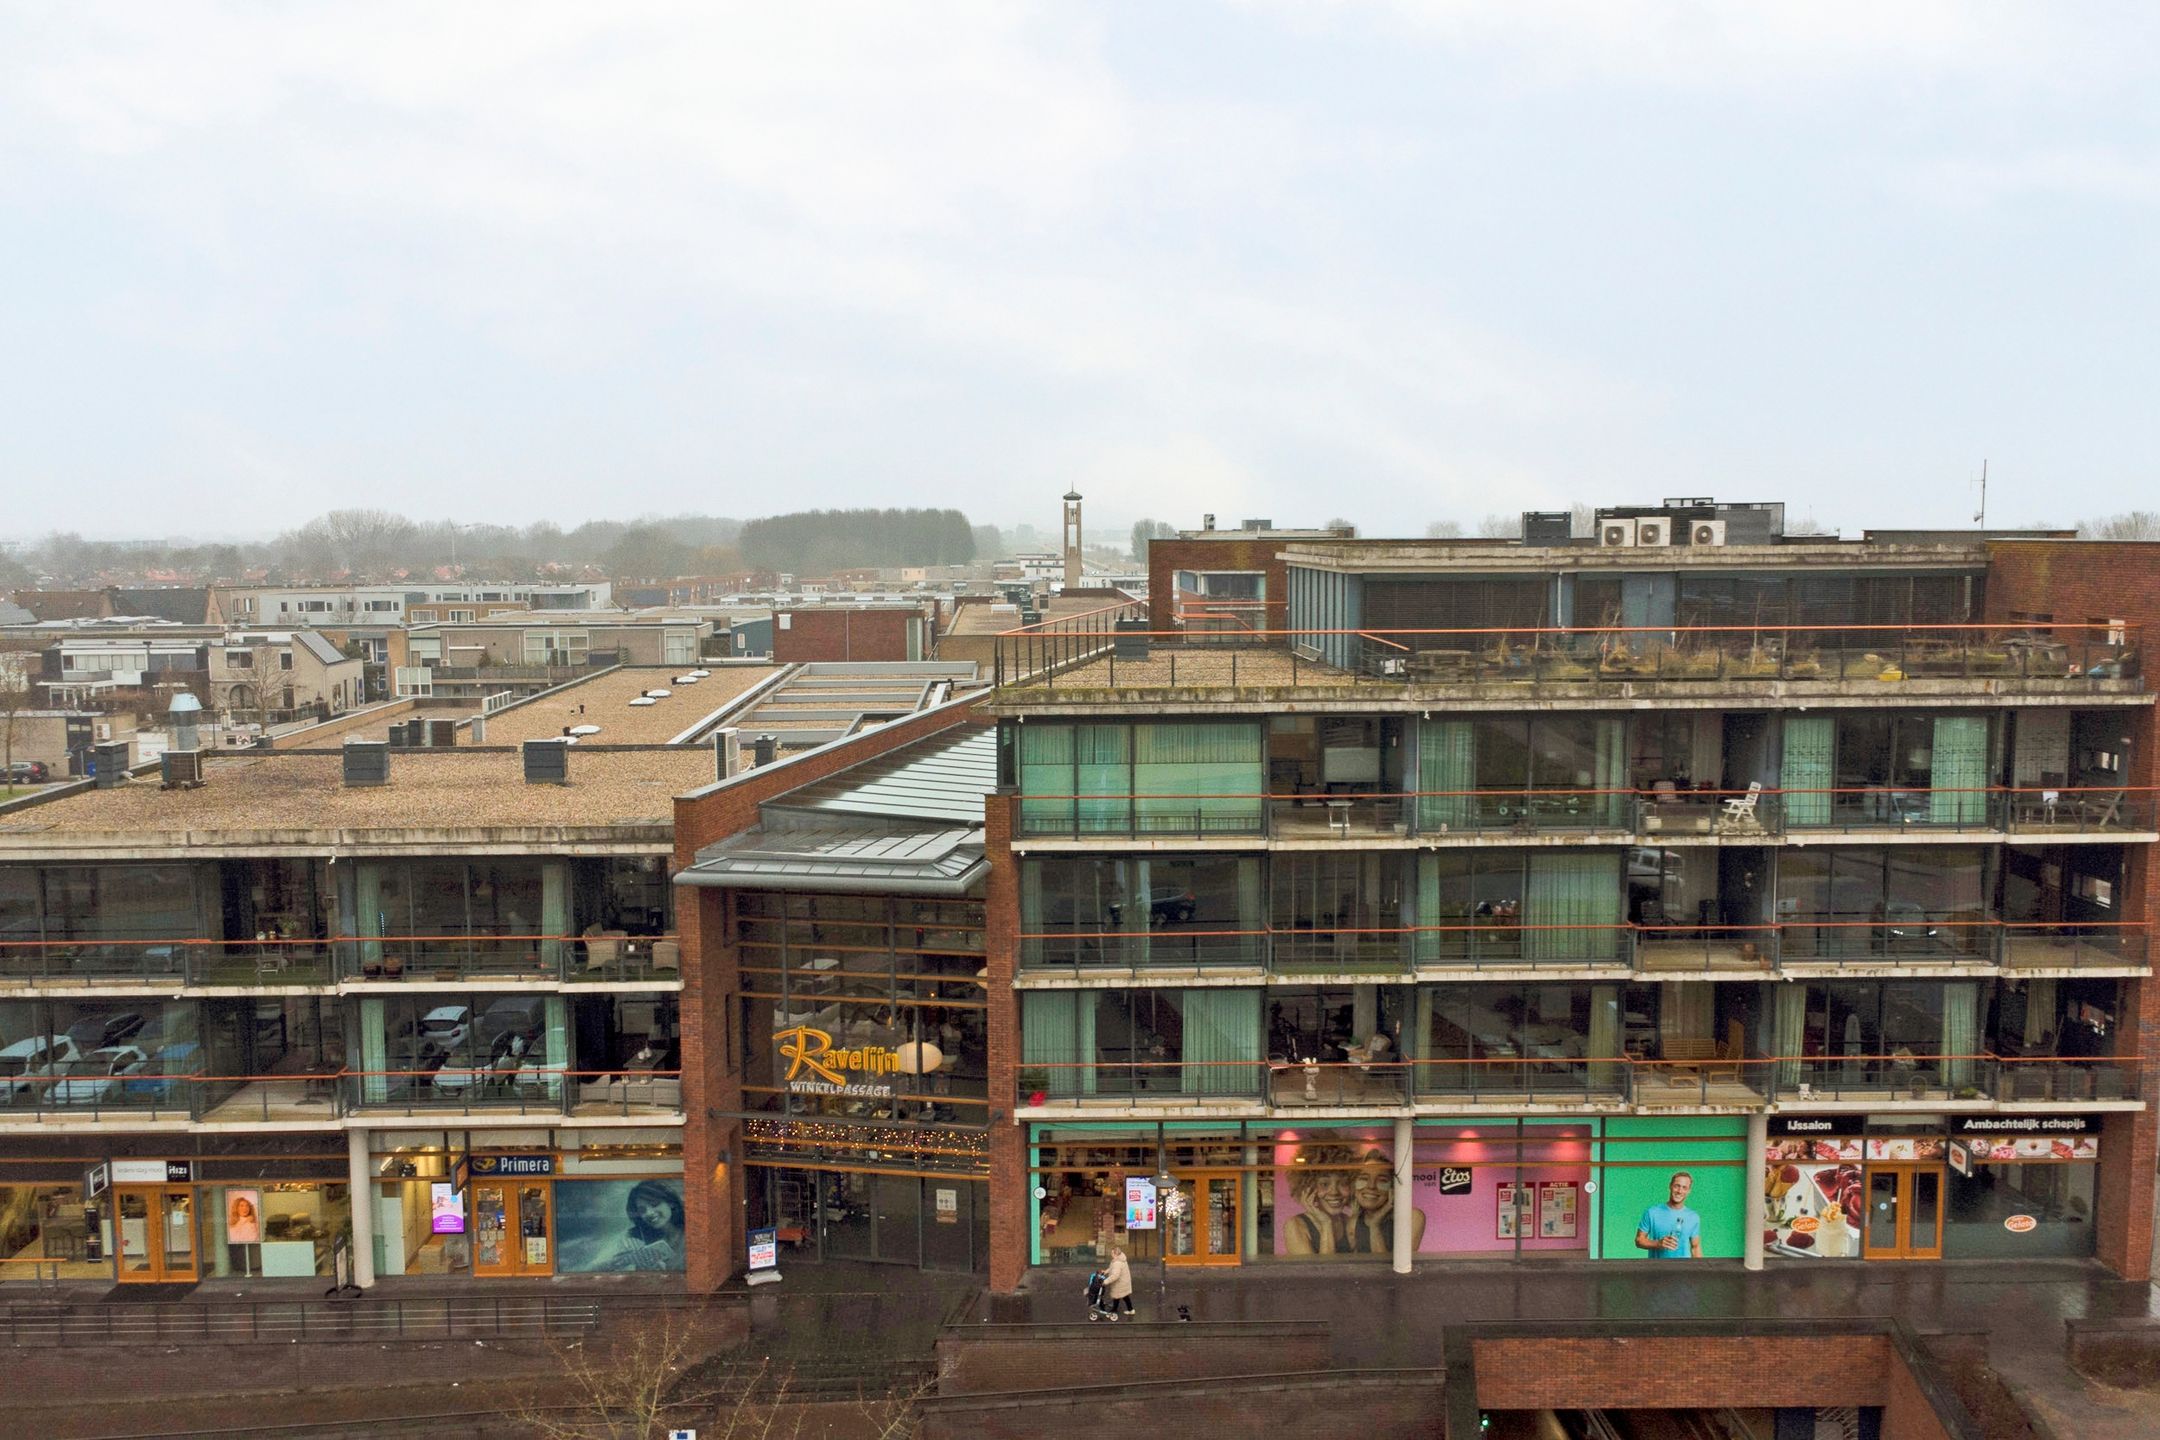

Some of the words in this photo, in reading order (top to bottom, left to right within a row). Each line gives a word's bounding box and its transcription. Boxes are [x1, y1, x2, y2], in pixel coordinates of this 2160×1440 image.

[772, 1025, 900, 1086] Ravelijn
[790, 1081, 891, 1097] WINKELPASSAGE
[1787, 1120, 1832, 1131] IJssalon
[1963, 1118, 2040, 1130] Ambachtelijk
[2041, 1118, 2086, 1130] schepijs
[168, 1165, 188, 1175] HIZI
[500, 1157, 550, 1172] Primera
[1441, 1167, 1471, 1185] Etos
